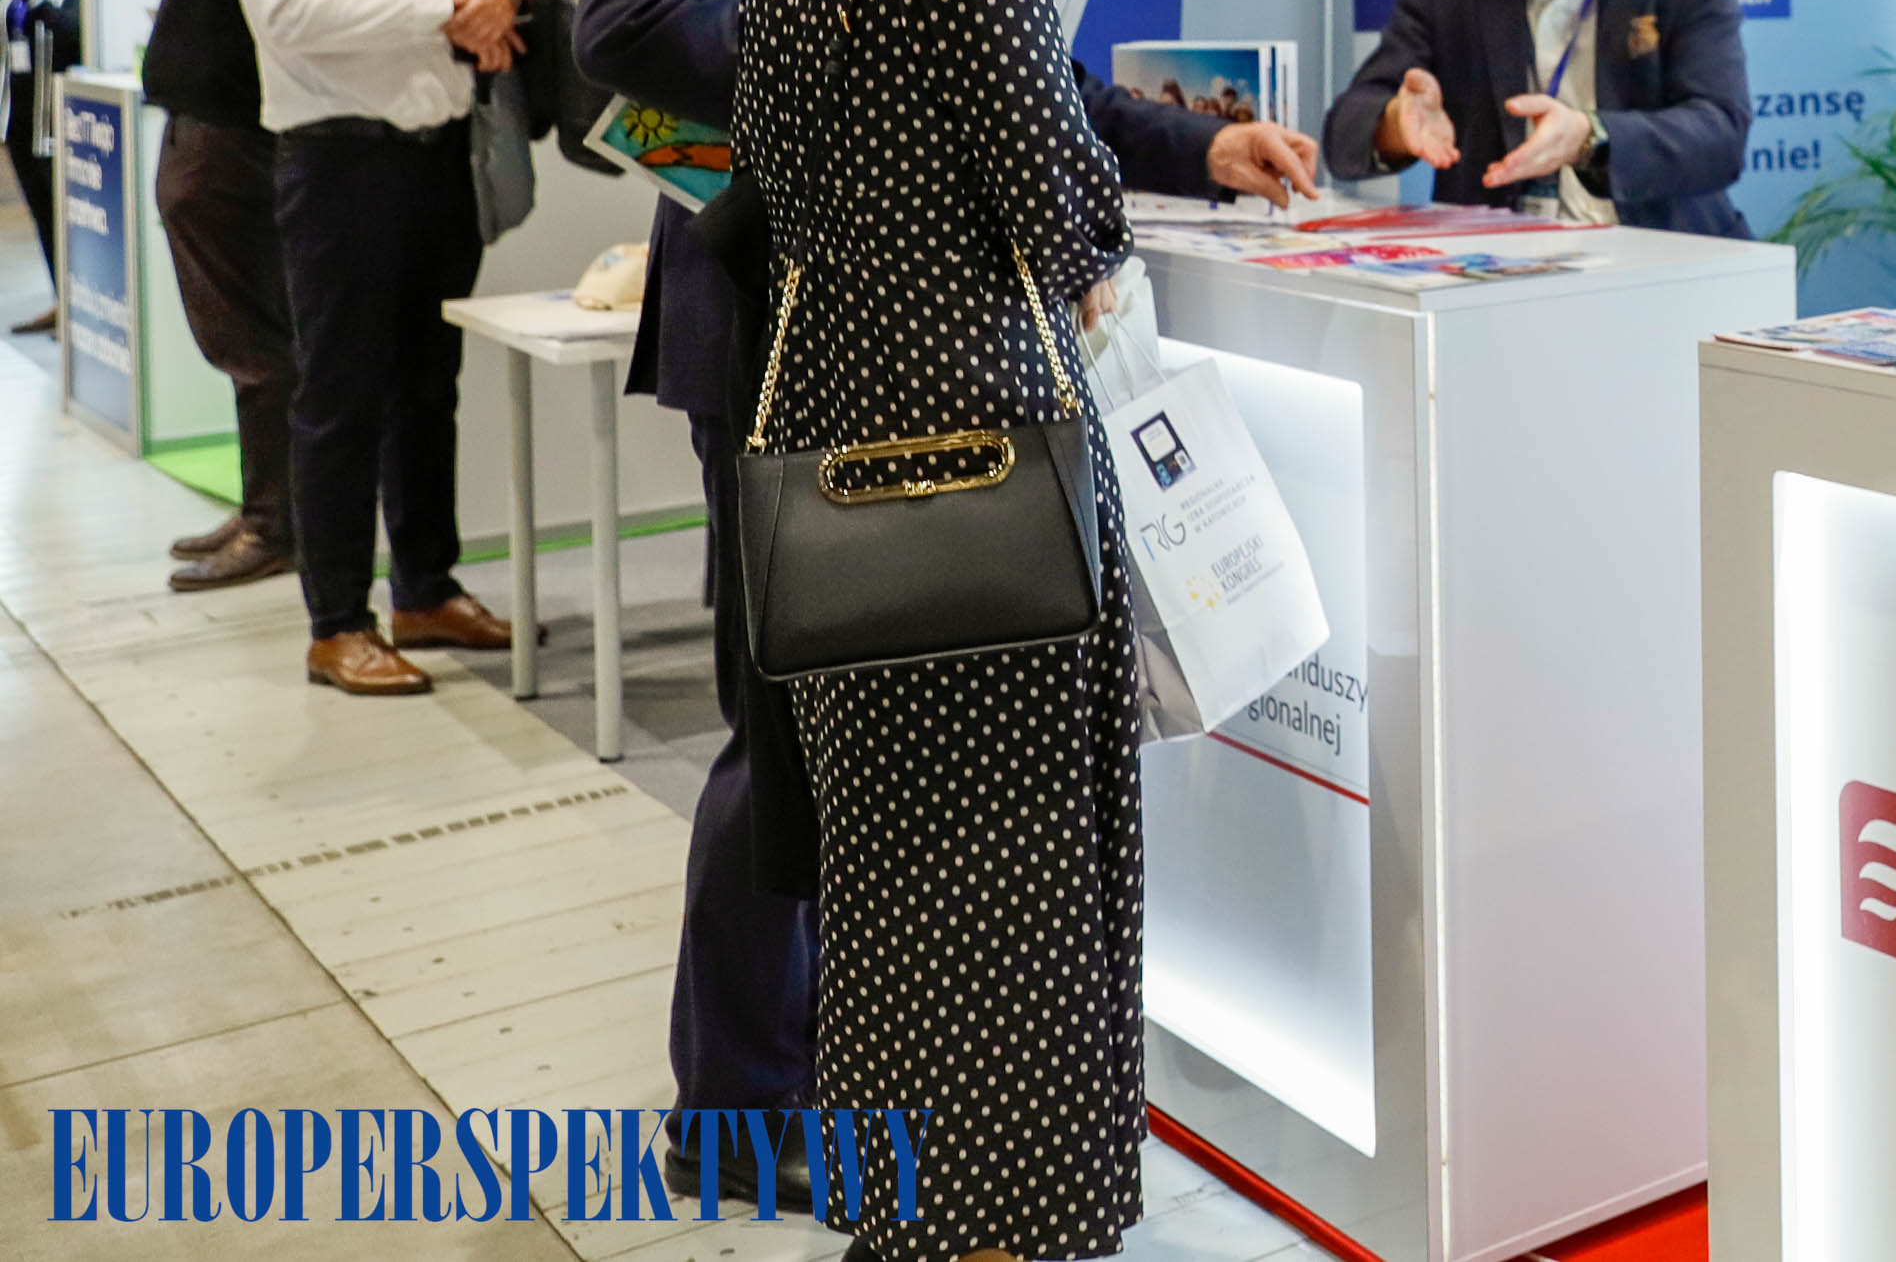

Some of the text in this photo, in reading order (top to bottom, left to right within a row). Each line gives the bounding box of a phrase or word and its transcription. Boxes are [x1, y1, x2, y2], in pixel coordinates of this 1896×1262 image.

[1755, 90, 1865, 123] zansę
[1751, 138, 1822, 172] nie!
[1288, 652, 1368, 713] nduszy
[1247, 695, 1342, 756] gionalnej
